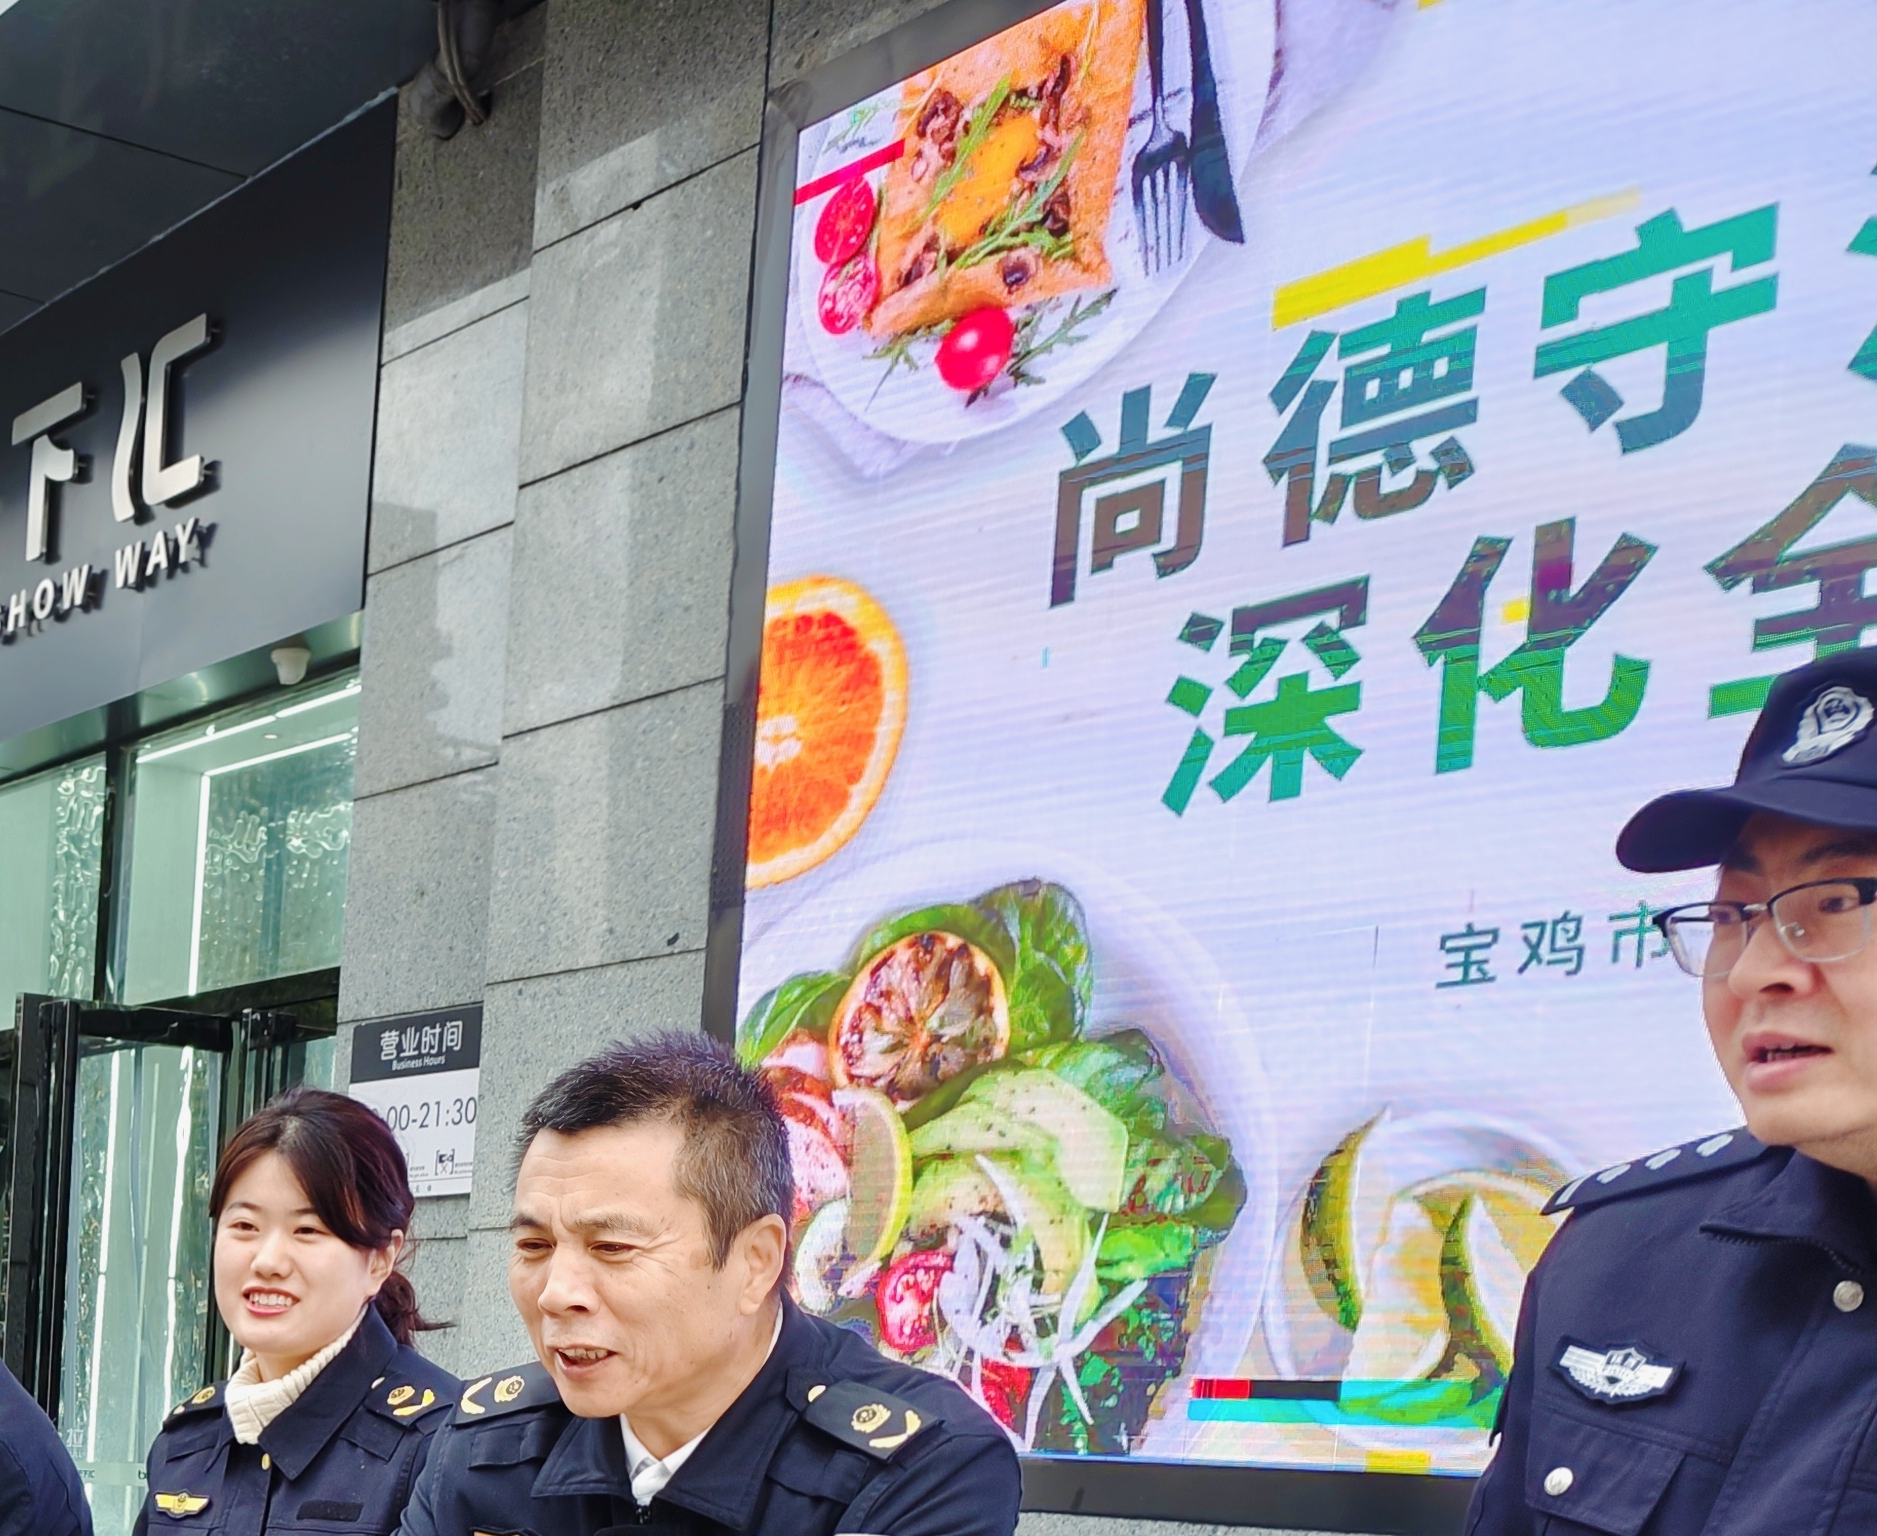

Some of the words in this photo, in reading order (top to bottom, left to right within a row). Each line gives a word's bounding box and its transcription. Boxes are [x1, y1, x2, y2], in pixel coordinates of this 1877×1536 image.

[1049, 162, 1877, 609] 尚德守
[114, 517, 201, 589] WAY
[380, 1020, 463, 1061] 营业时间
[391, 1057, 423, 1071] Business
[423, 1054, 446, 1066] Hours
[374, 1096, 478, 1133] 00-21:30
